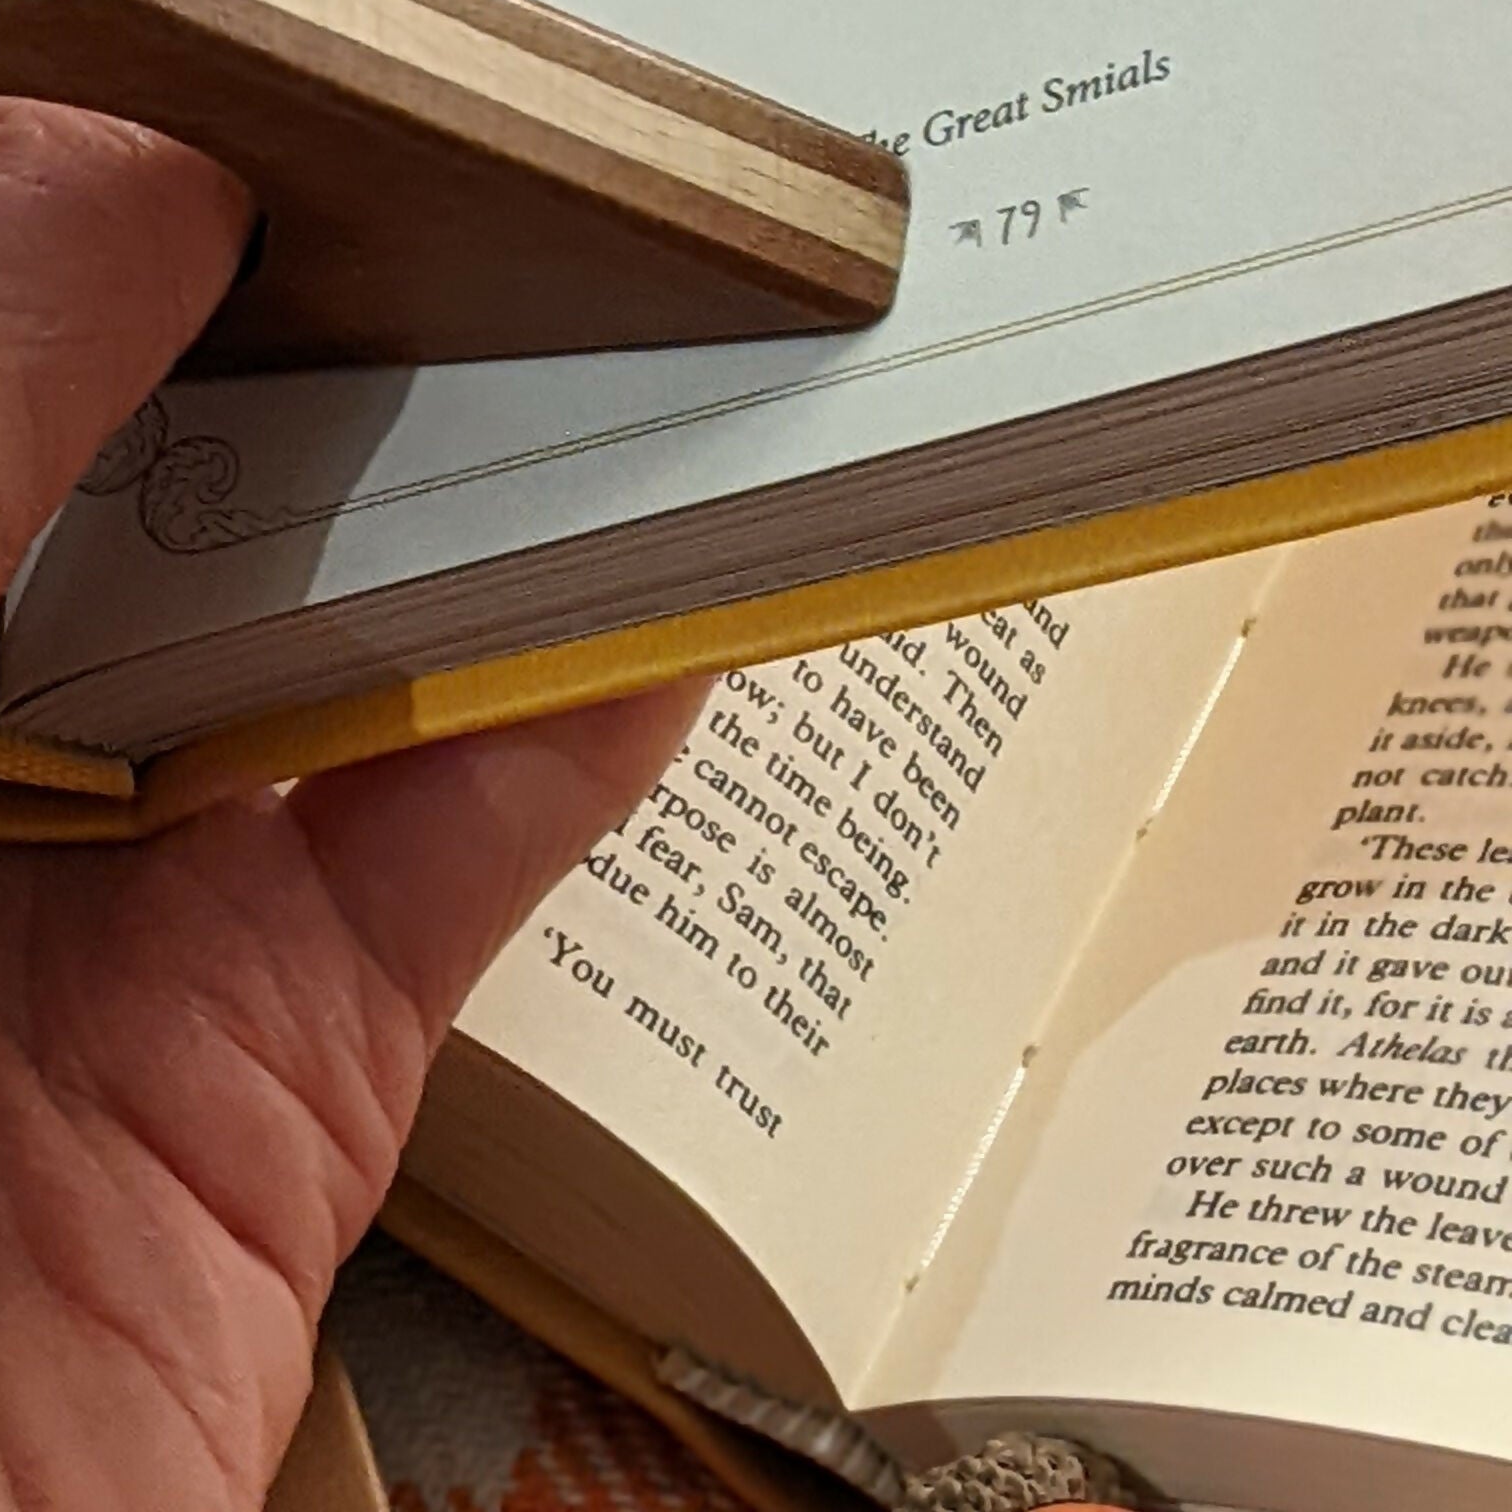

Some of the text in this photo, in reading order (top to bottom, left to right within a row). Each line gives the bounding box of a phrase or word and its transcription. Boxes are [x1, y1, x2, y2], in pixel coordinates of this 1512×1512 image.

[923, 92, 1029, 146] Great
[1041, 49, 1170, 113] Smials
[996, 200, 1041, 246] 79
[946, 623, 1028, 721] wound
[1020, 650, 1045, 685] as
[839, 645, 986, 794] understand
[943, 669, 1002, 758] Then
[793, 660, 960, 831] to have been
[709, 711, 910, 905] the time being.
[793, 710, 940, 869] but I don't
[694, 760, 888, 942] cannot escape.
[746, 847, 874, 982] is almost
[1295, 872, 1496, 905] grow in the
[635, 826, 851, 1021] fear, Sam, that
[1279, 910, 1512, 944] it in the dark
[654, 893, 829, 1056] him to their
[1260, 949, 1450, 983] and it gave
[1242, 987, 1493, 1026] find it, for it is
[624, 996, 706, 1068] must
[715, 1065, 782, 1139] trust
[1224, 1028, 1468, 1065] earth. Athelas
[1201, 1067, 1512, 1121] places where they
[1186, 1116, 1508, 1158] except to some of
[1167, 1154, 1509, 1204] over such a wound
[1185, 1190, 1418, 1236] He threw the
[1125, 1229, 1403, 1280] fragrance of the
[1106, 1272, 1433, 1331] minds calmed and
